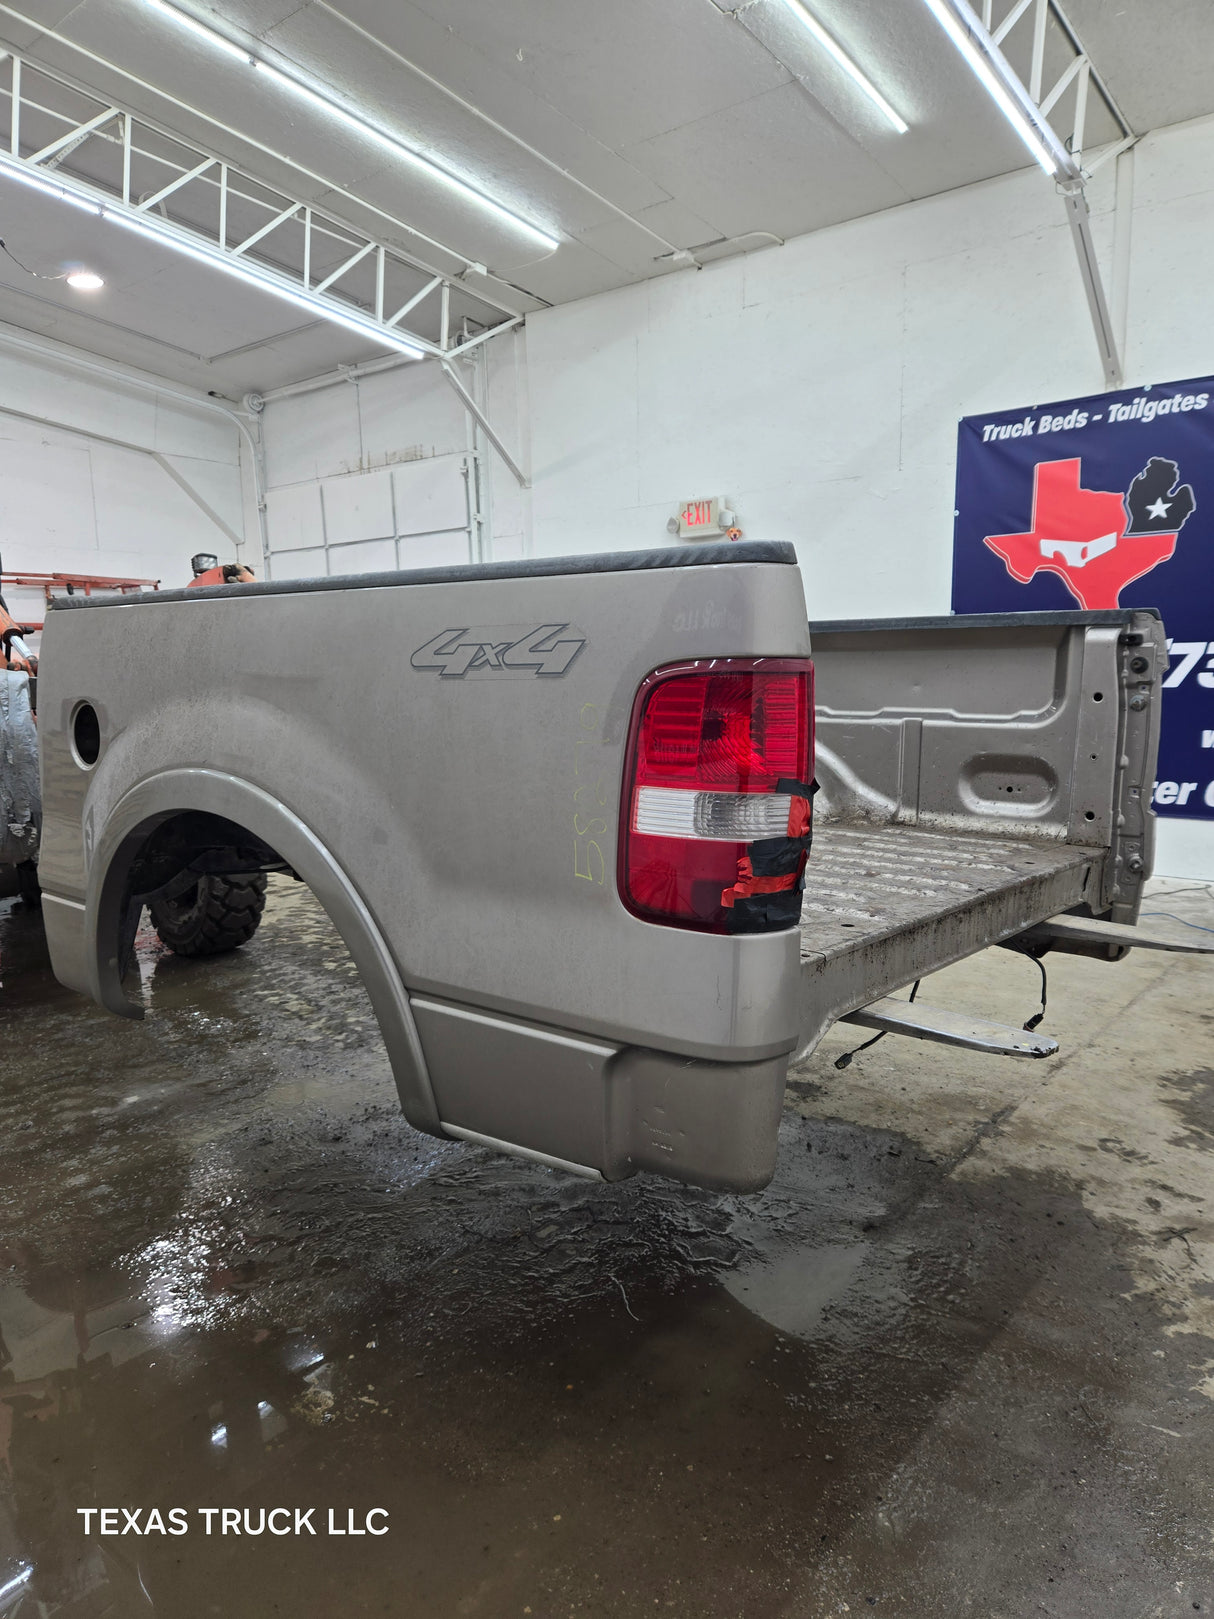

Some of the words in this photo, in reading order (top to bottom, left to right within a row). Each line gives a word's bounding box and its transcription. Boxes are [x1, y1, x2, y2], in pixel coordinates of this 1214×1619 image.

[982, 417, 1036, 442] Truck
[1037, 409, 1089, 434] Beds
[1107, 393, 1210, 422] Tailgates
[687, 500, 712, 526] EXIT
[410, 623, 588, 678] 4x4
